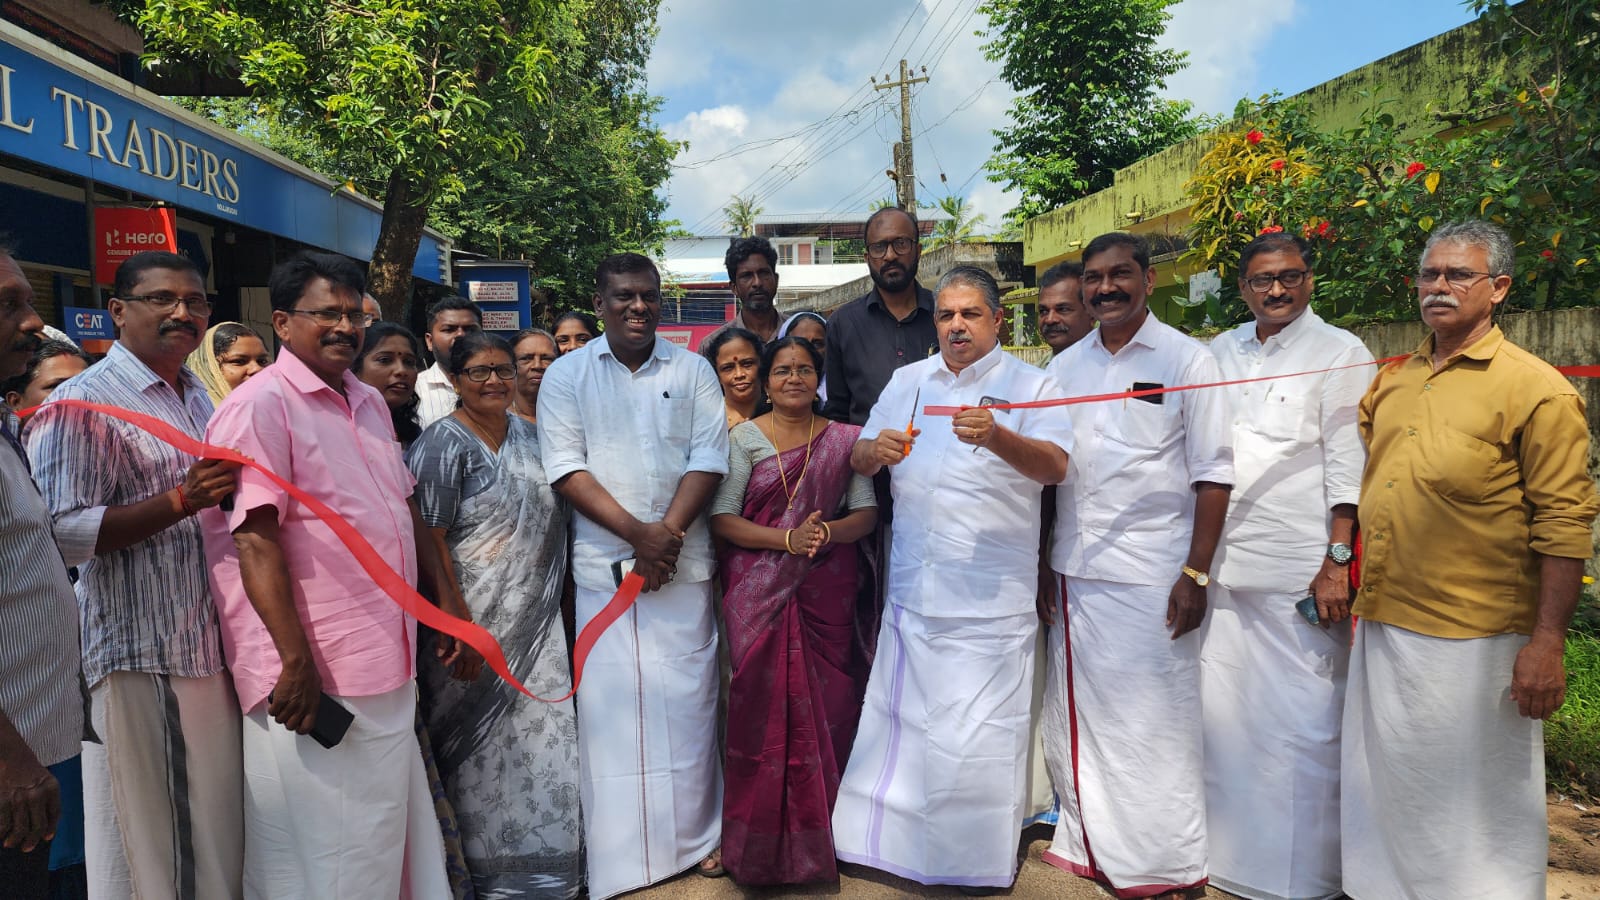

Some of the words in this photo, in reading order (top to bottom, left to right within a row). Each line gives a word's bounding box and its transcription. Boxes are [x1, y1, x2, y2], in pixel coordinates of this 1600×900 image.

[0, 64, 34, 135] L
[52, 86, 240, 204] TRADERS
[75, 312, 104, 329] CEAT
